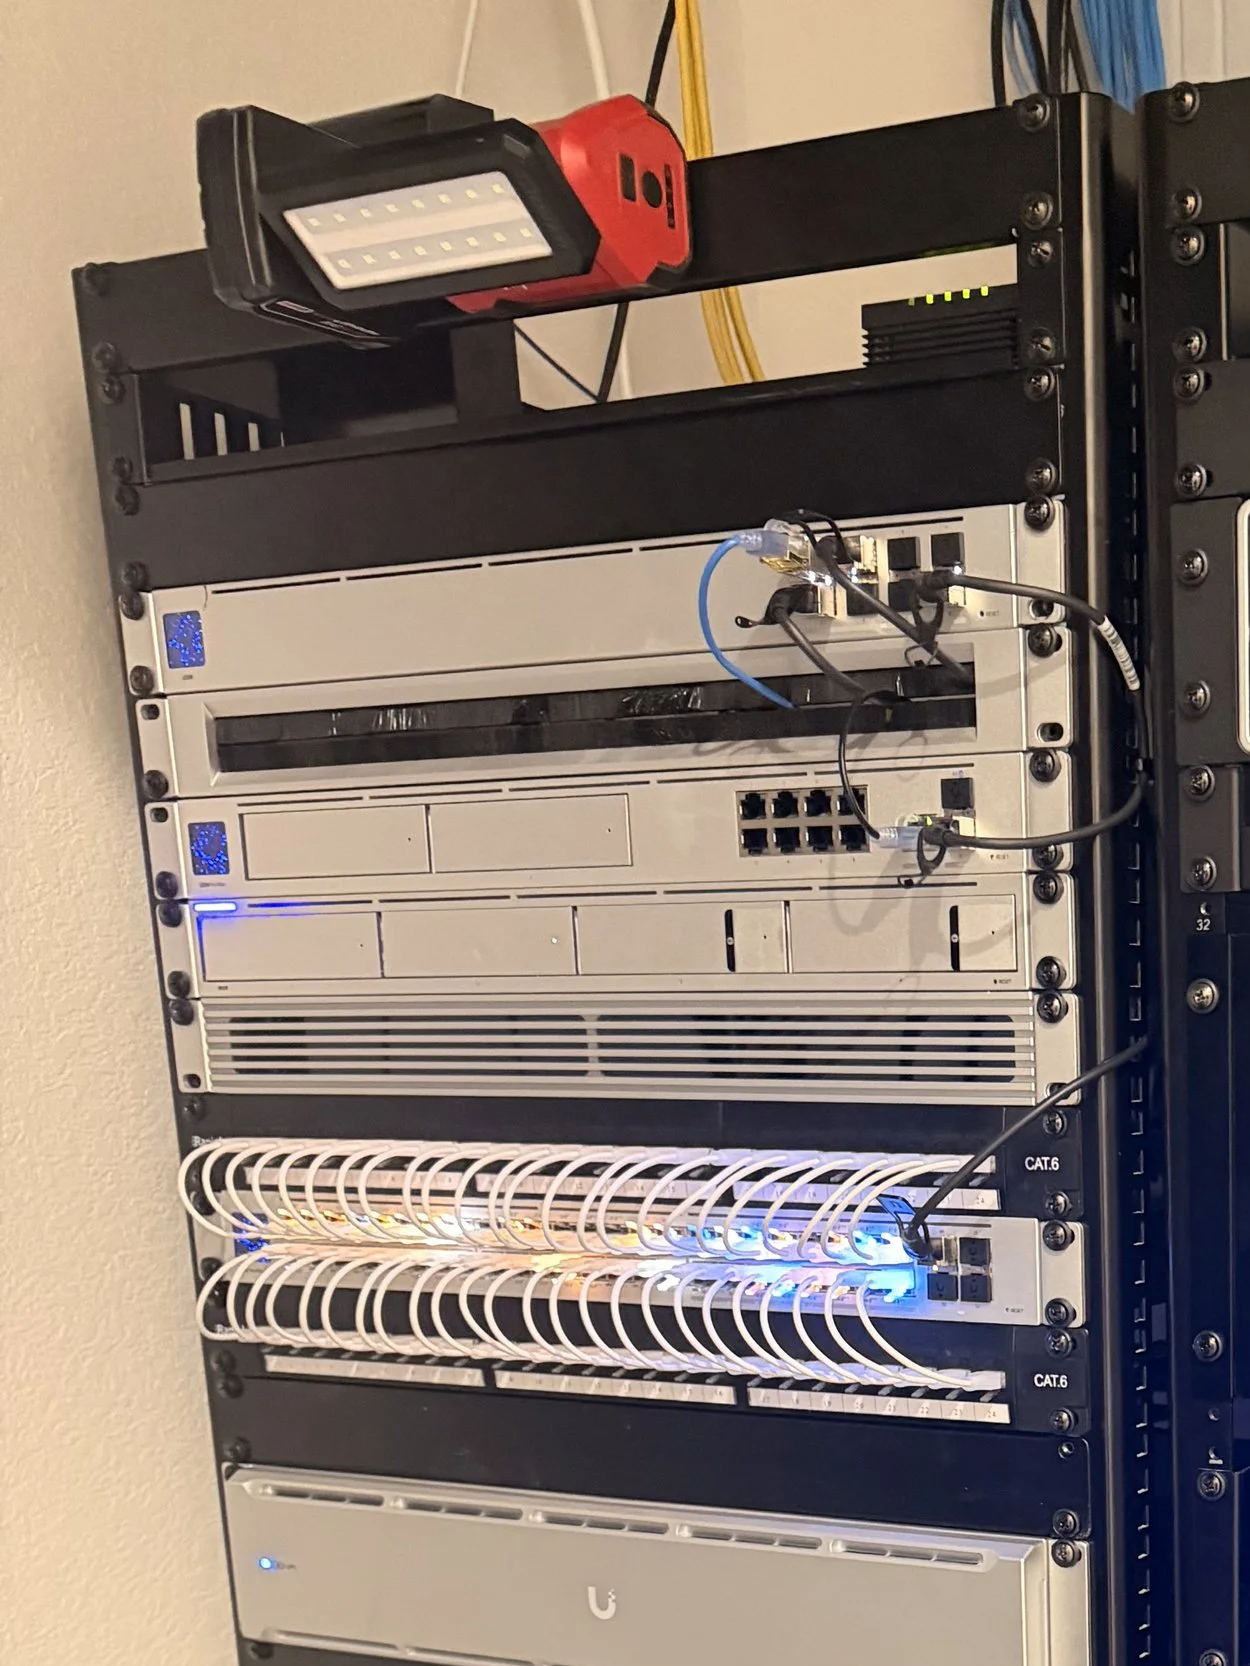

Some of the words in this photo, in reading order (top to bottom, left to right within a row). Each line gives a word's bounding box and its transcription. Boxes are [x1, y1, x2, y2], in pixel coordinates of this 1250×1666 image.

[1196, 919, 1211, 931] 32
[1025, 1156, 1060, 1171] CAT.6
[1034, 1373, 1068, 1389] CAT.6
